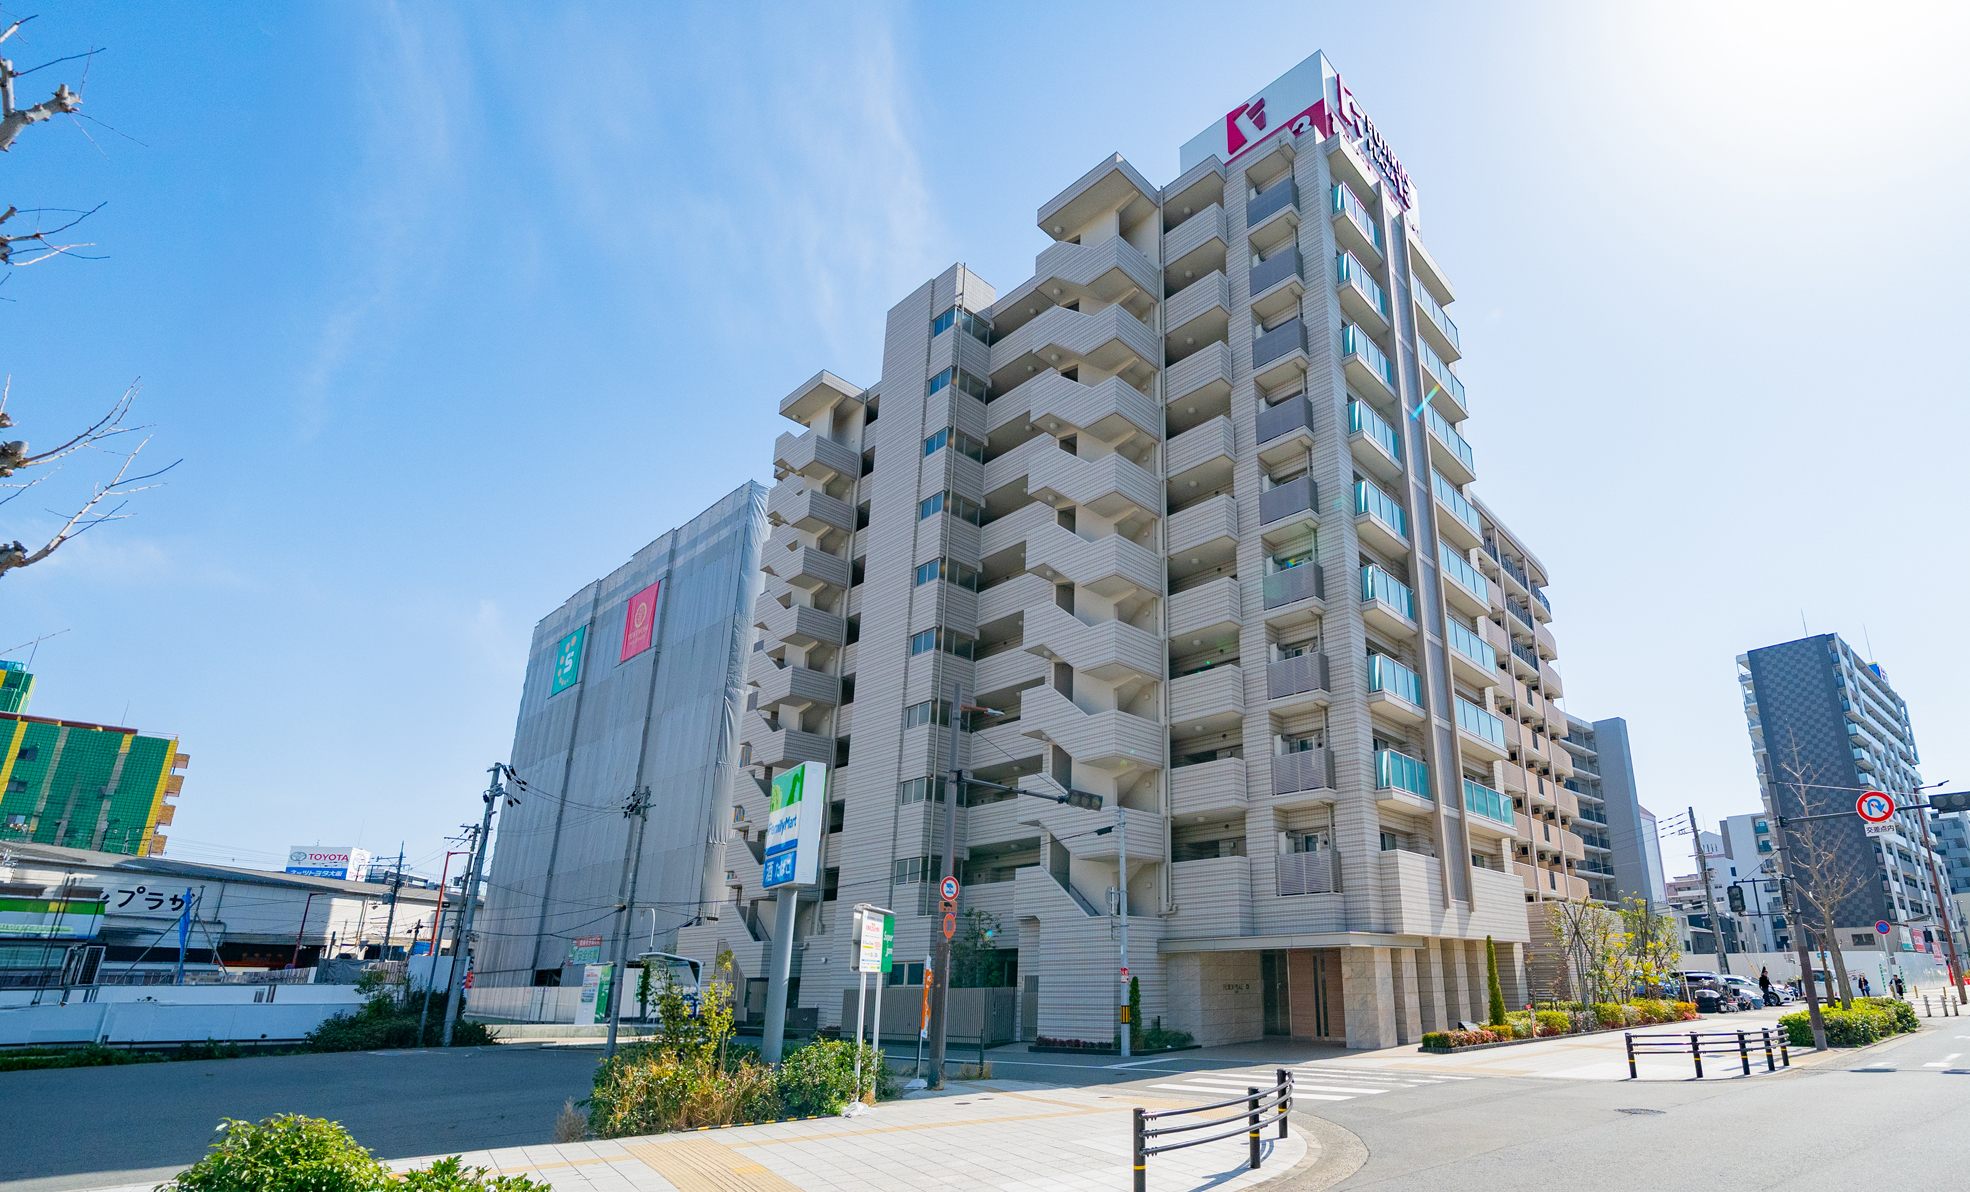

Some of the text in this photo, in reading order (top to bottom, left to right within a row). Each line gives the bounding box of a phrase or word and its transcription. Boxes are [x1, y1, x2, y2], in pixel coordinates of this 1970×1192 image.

[1367, 138, 1398, 187] PLAZA
[767, 814, 797, 836] FamilyMart
[1866, 824, 1895, 834] 交差点内
[308, 853, 349, 862] TOYOTA
[765, 858, 791, 882] 酒 たばこ
